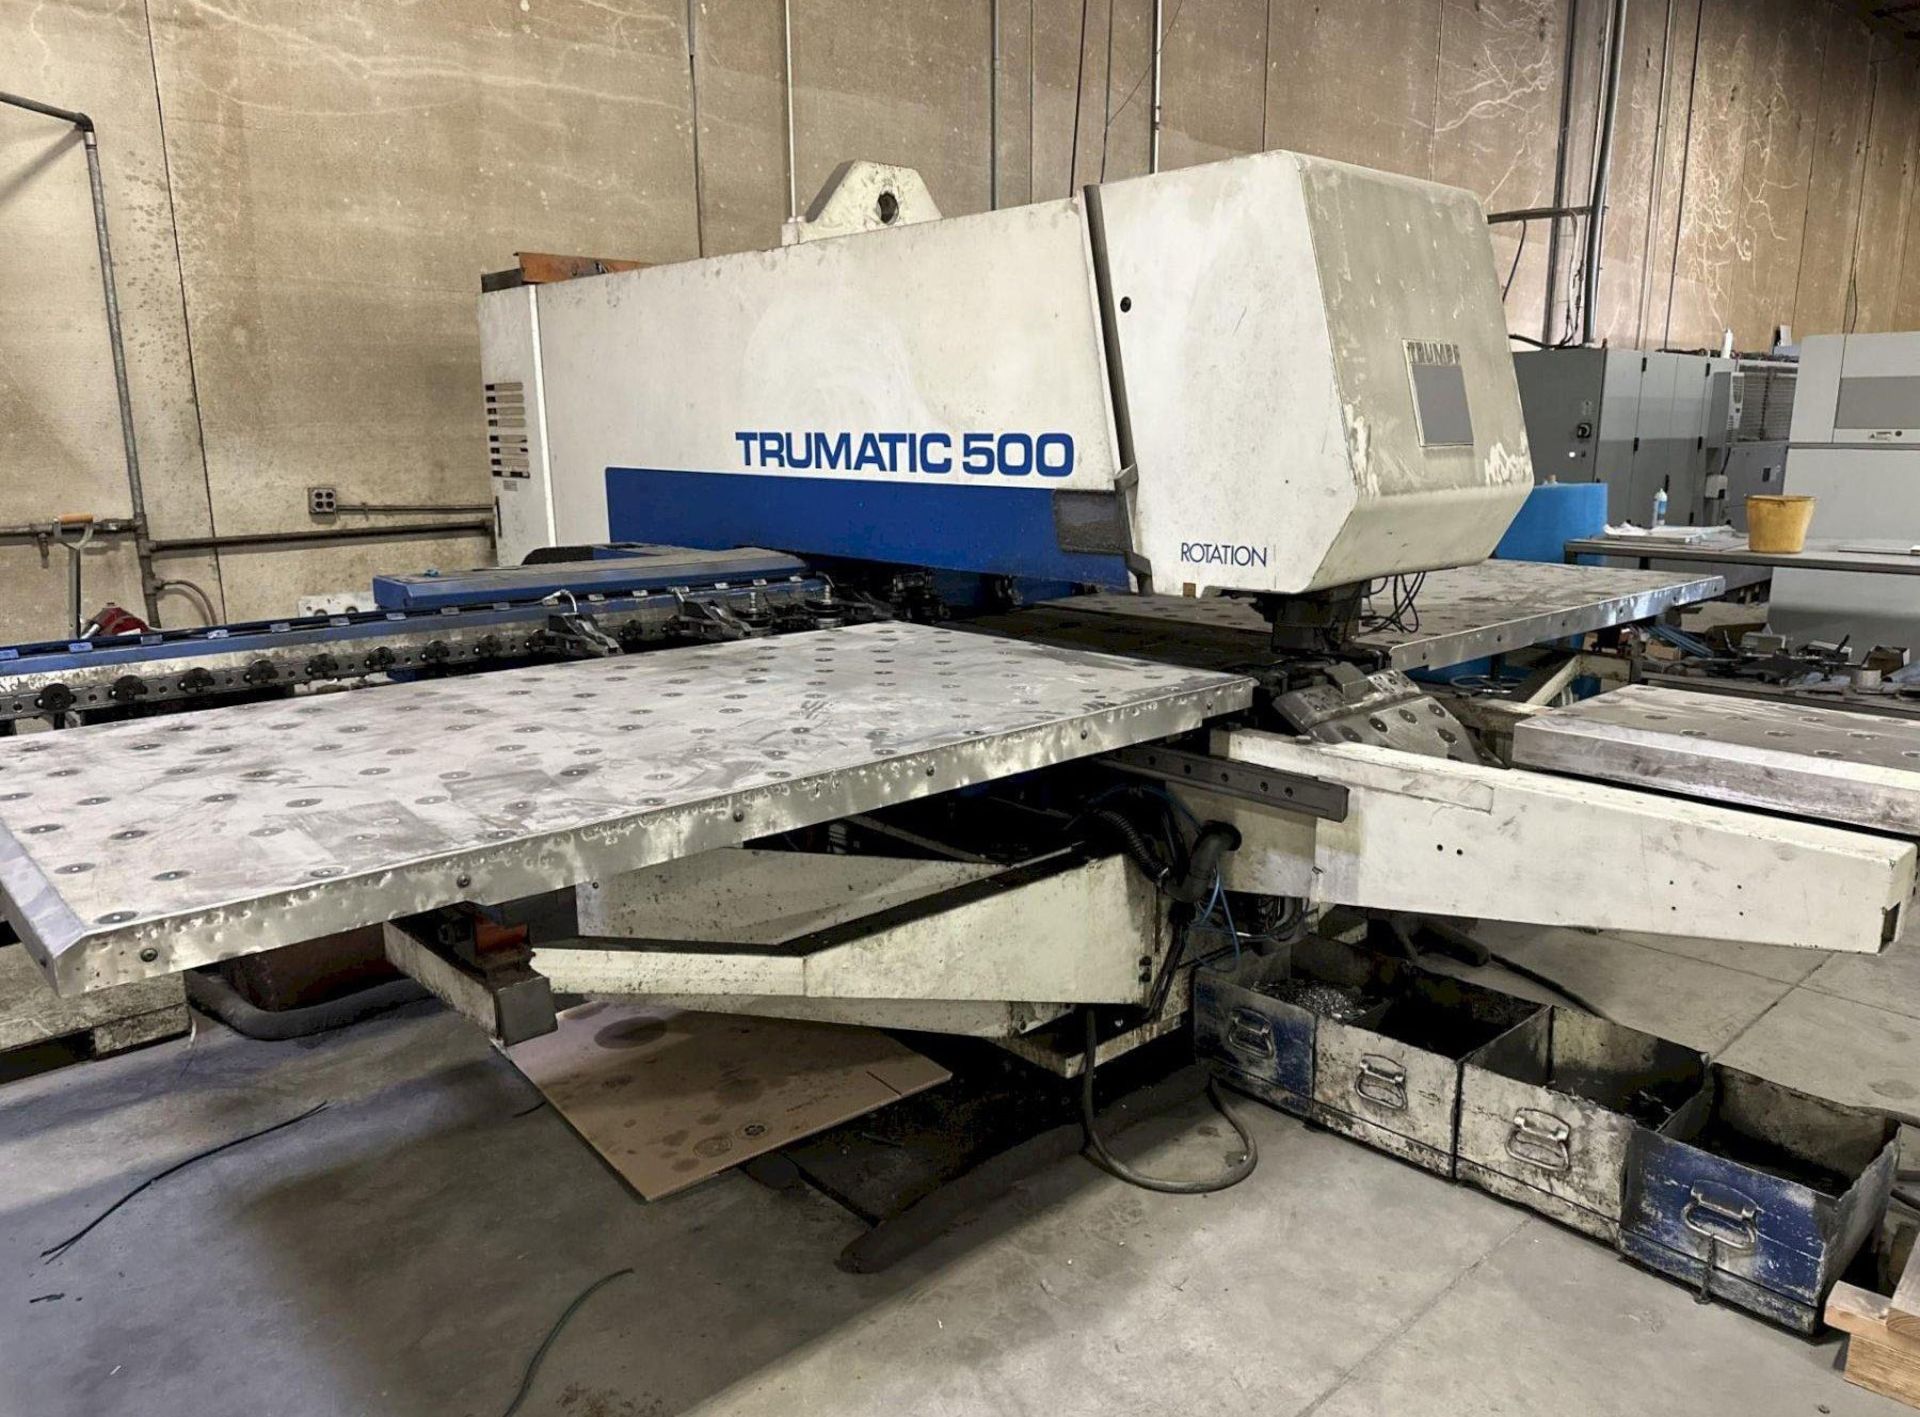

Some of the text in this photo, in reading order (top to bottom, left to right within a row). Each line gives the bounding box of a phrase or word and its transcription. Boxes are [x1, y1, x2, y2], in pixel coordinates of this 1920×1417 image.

[735, 432, 1074, 477] TRUMATIC 500
[1181, 542, 1267, 567] ROTATION
